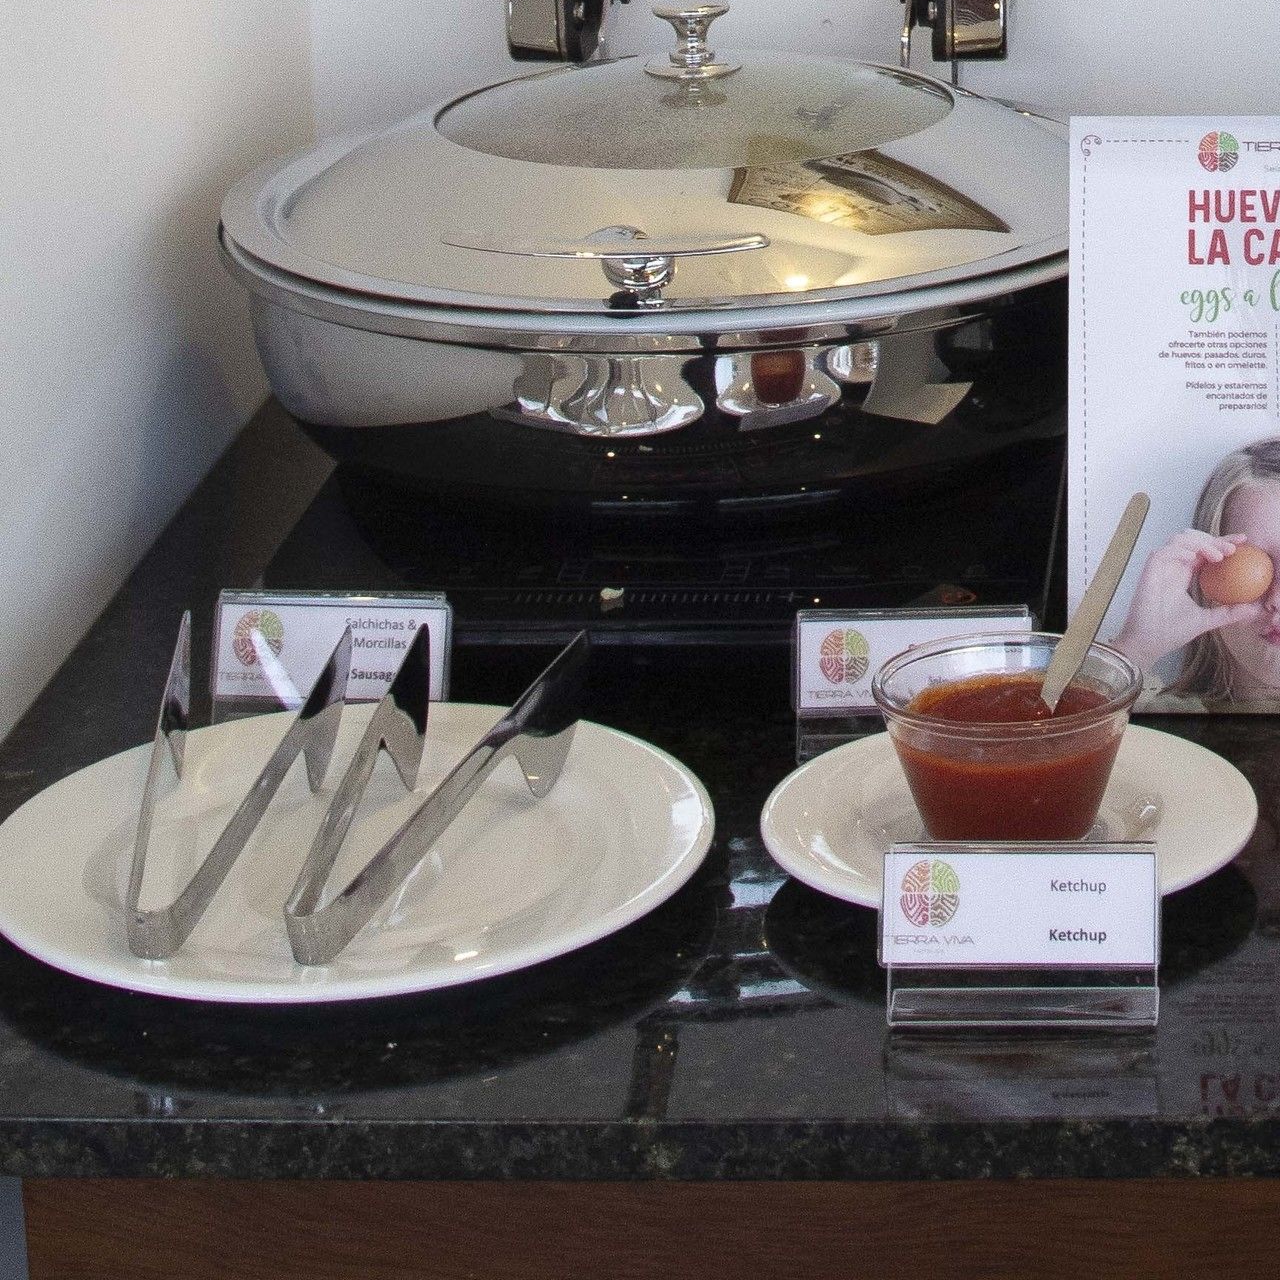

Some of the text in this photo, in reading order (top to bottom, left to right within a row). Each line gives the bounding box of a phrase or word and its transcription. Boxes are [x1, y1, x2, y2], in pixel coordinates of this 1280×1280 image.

[1187, 228, 1232, 266] LA
[1179, 286, 1233, 323] eggs
[1242, 288, 1261, 308] a
[353, 637, 407, 649] Morcillas
[1050, 878, 1107, 895] Ketchup
[1049, 928, 1108, 944] Ketchup
